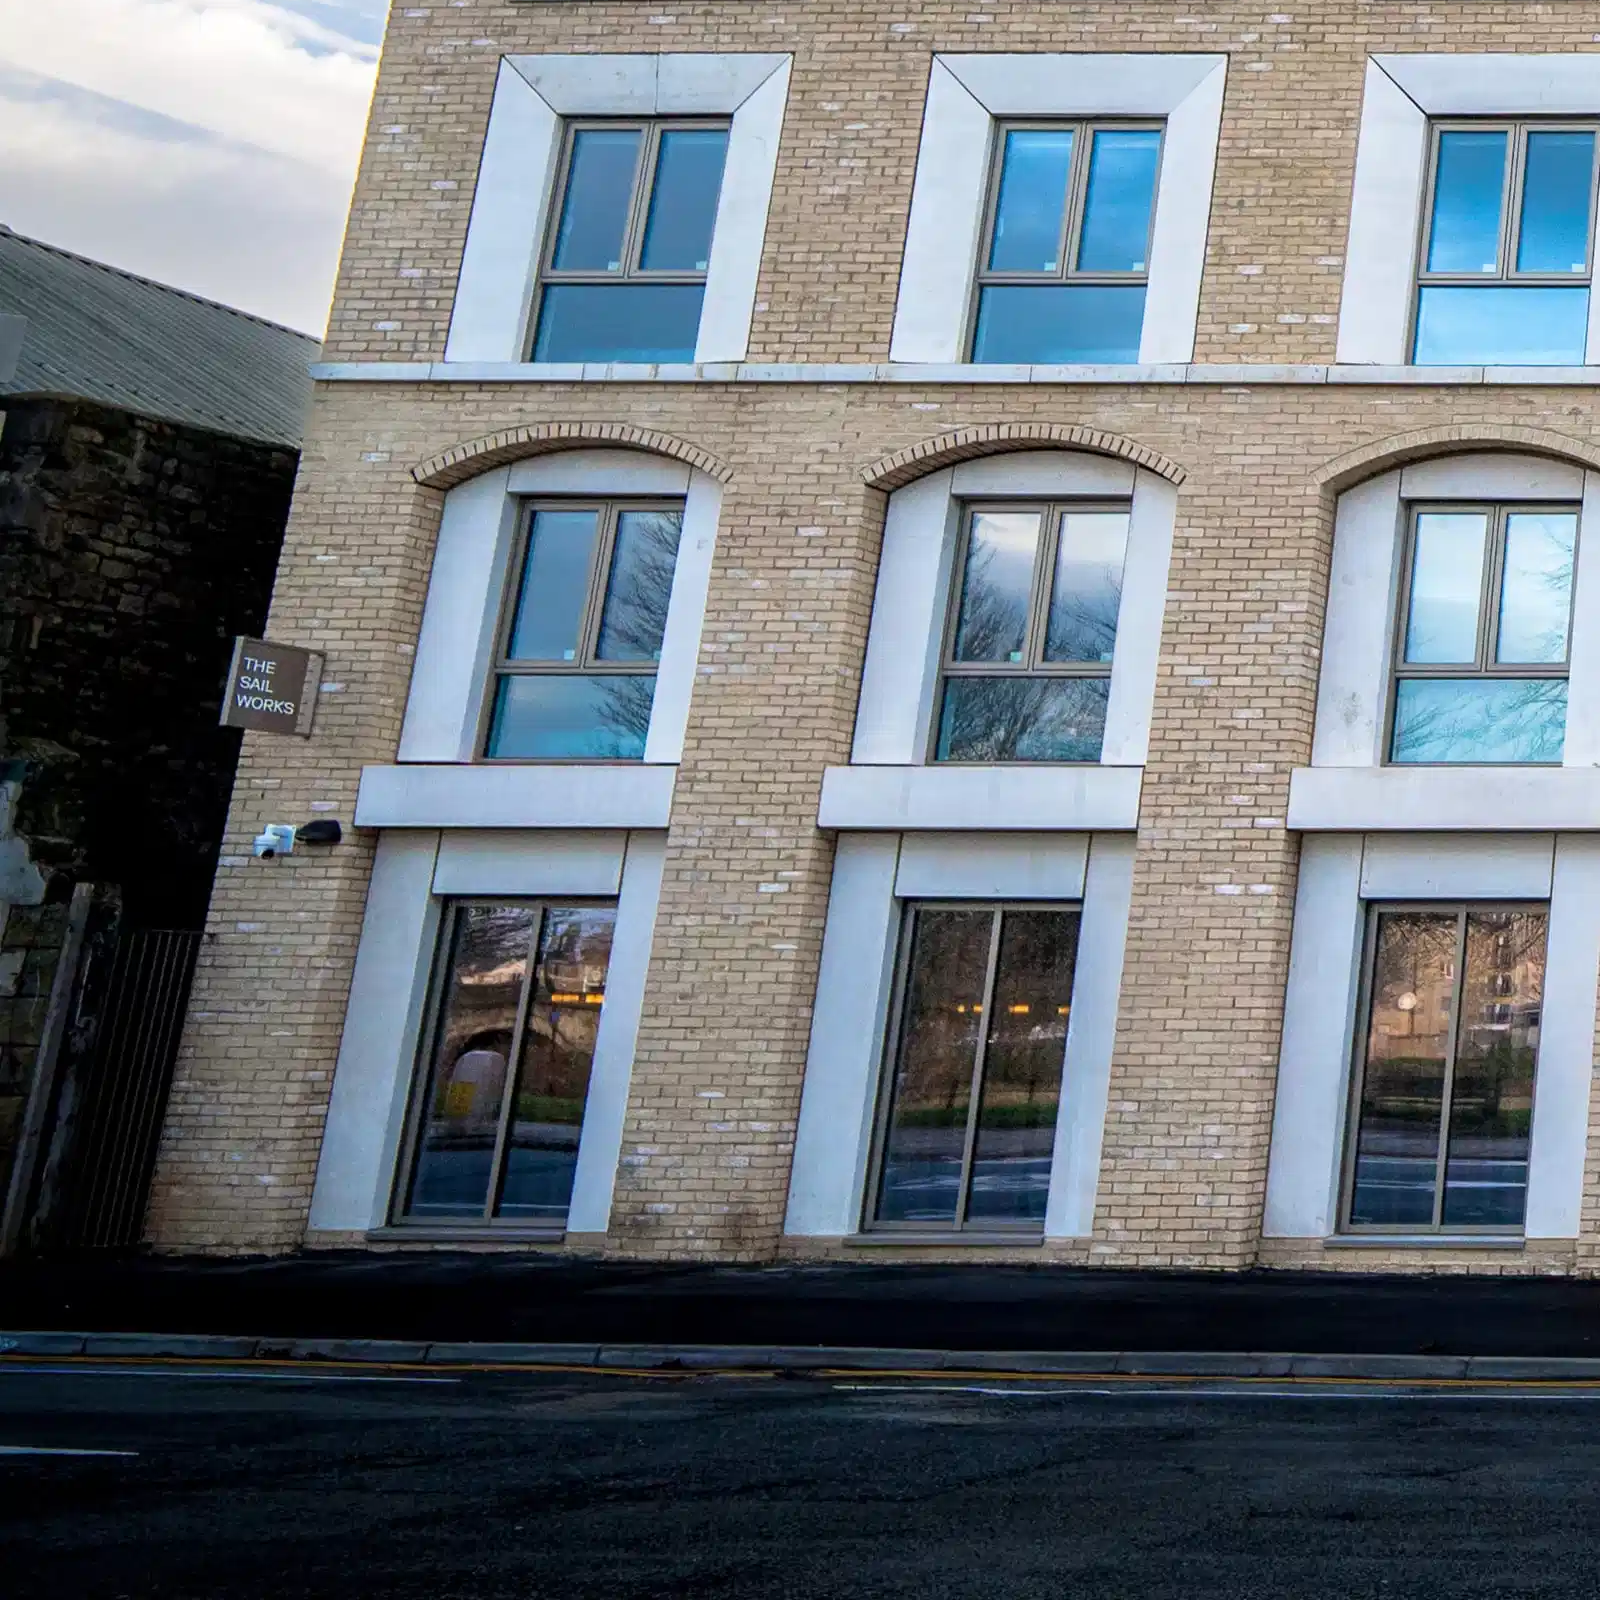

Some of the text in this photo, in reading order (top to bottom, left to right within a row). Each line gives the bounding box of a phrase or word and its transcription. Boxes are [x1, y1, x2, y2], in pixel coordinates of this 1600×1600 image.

[244, 656, 277, 675] THE
[240, 676, 273, 693] SAIL
[237, 694, 295, 715] WORKS
